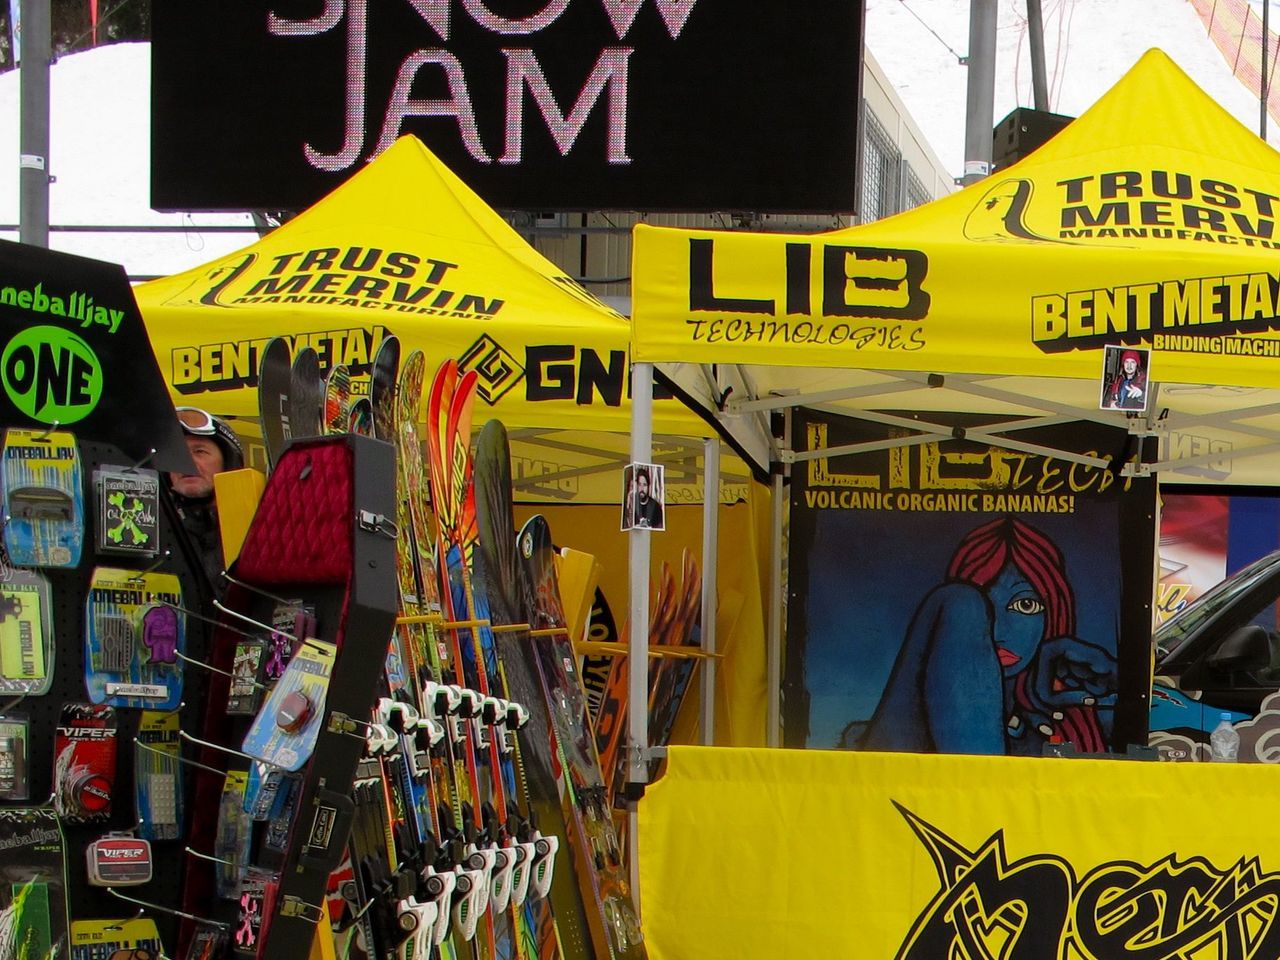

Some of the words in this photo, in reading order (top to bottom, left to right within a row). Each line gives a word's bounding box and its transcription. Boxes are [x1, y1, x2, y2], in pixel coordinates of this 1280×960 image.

[303, 42, 636, 172] JAM
[1056, 170, 1280, 218] TRUST
[267, 246, 459, 284] TRUST
[689, 238, 930, 321] LIB
[0, 283, 124, 334] neballjay
[232, 296, 494, 321] MANUFACTURING
[246, 272, 506, 317] MERVIN
[685, 319, 927, 351] TECHNOLOGIES
[1153, 334, 1223, 355] BINDING
[6, 343, 94, 416] ONE
[525, 345, 632, 406] GN
[807, 422, 1010, 491] LIB
[805, 490, 893, 511] VOLCANIC
[897, 491, 978, 512] ORGANIC
[983, 492, 1075, 513] BANANAS!
[56, 727, 117, 737] VIPER
[98, 848, 143, 857] VIPER
